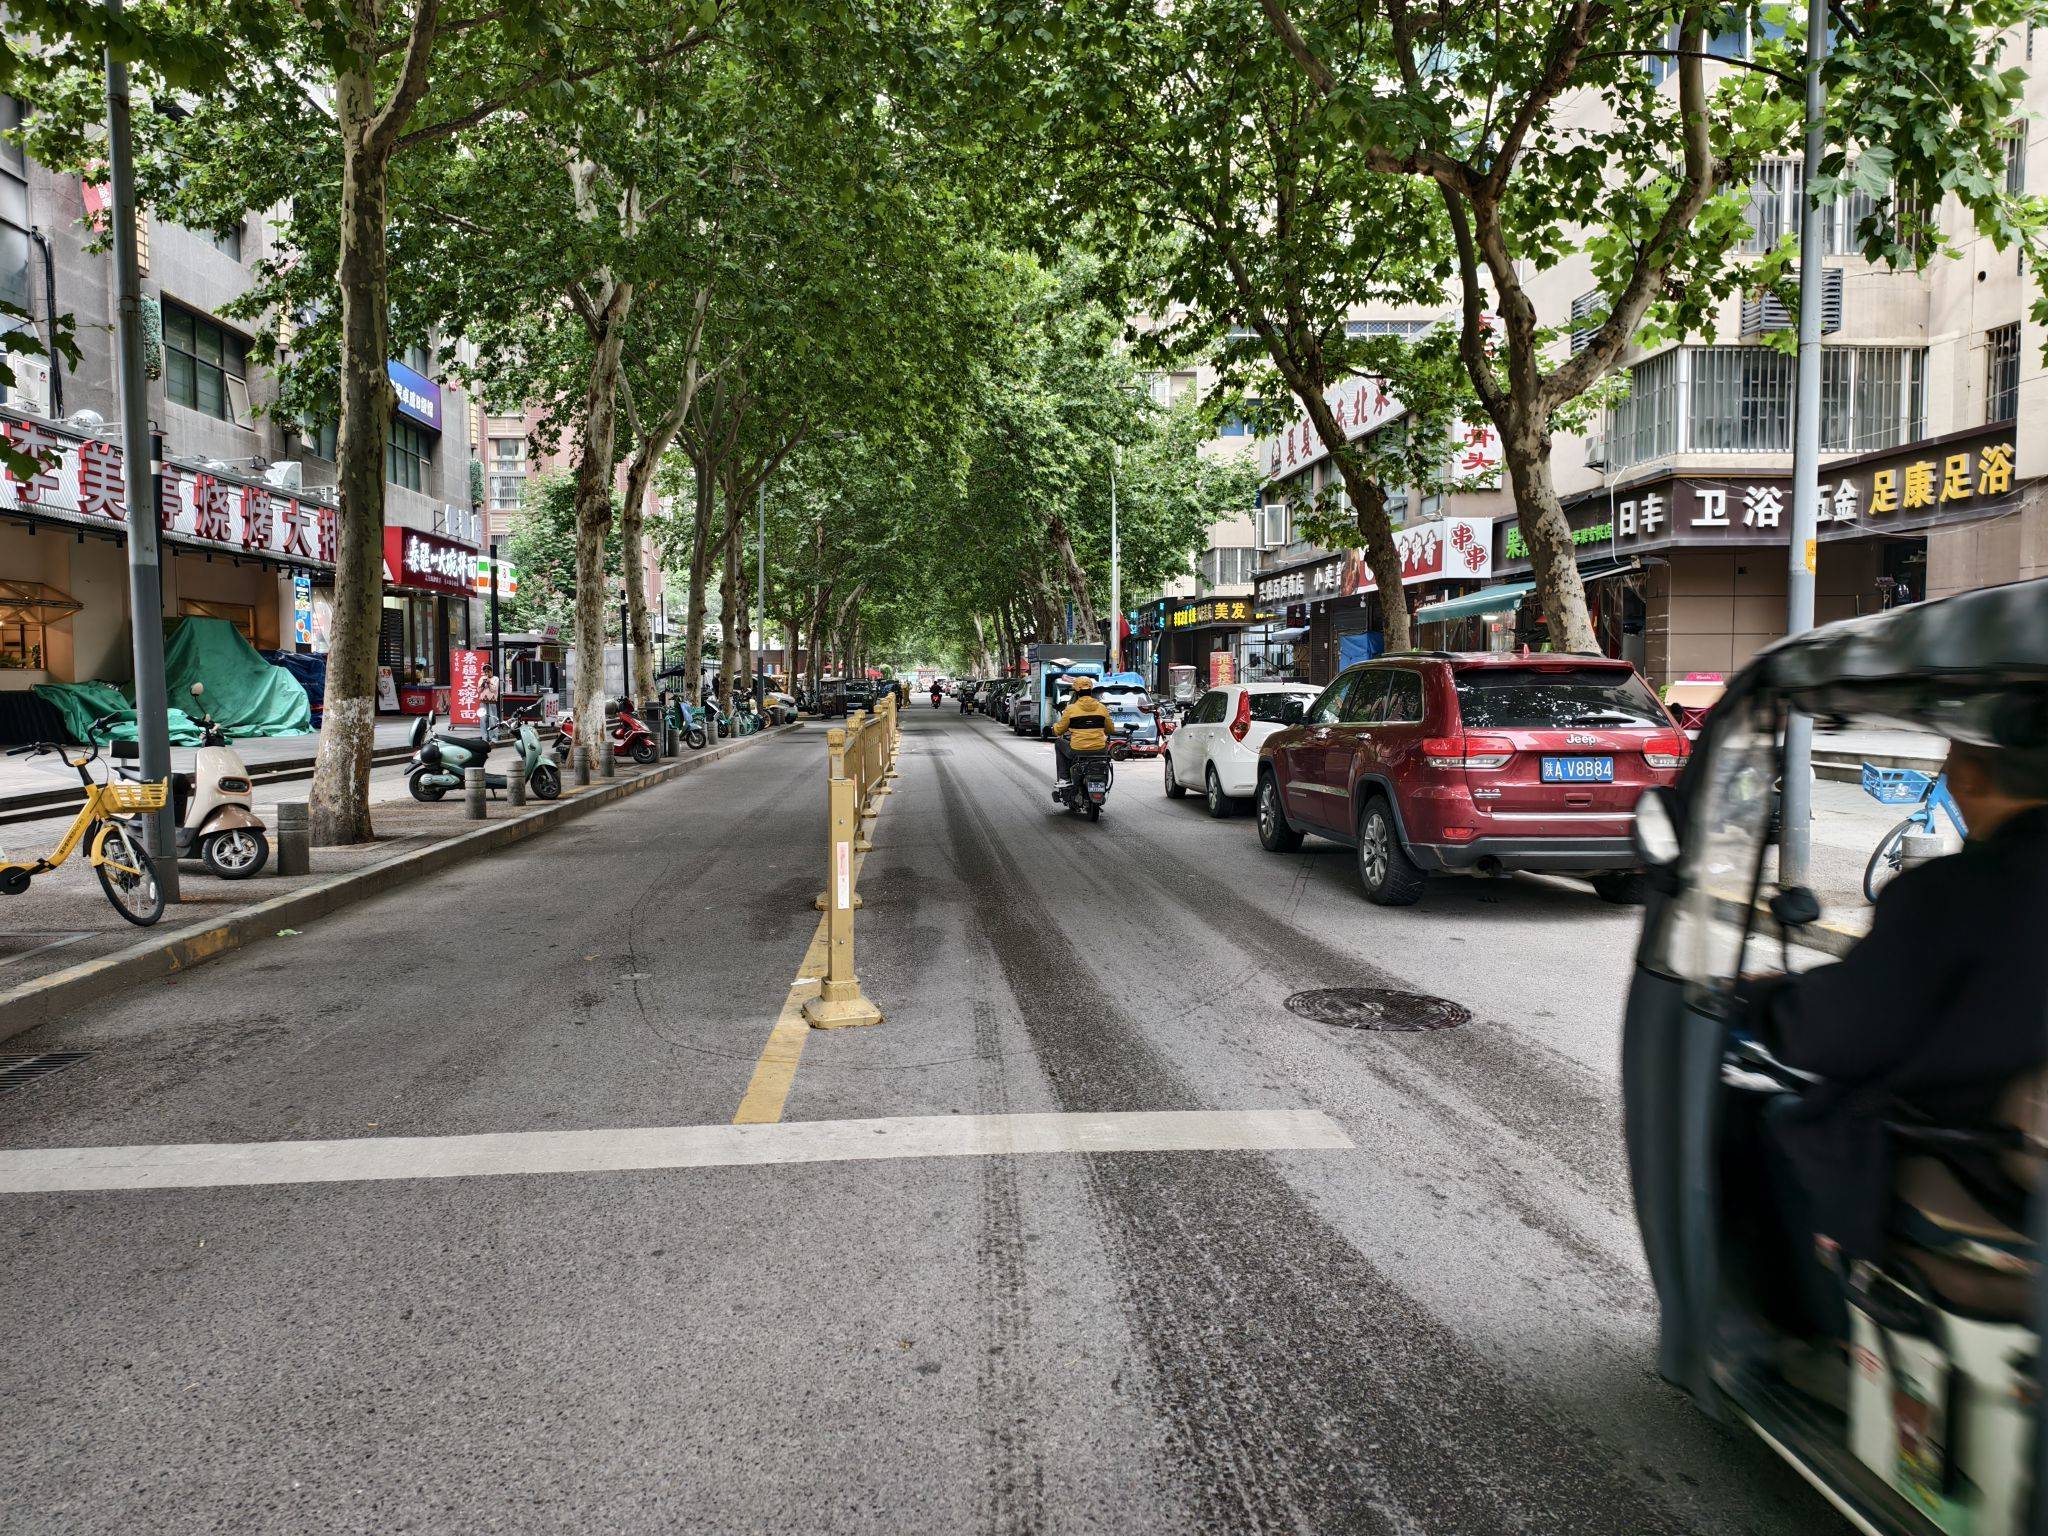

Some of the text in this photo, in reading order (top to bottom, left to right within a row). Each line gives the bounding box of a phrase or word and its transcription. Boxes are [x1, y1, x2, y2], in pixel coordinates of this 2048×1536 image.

[1869, 443, 2015, 515] 足康足浴
[1214, 602, 1246, 620] 美发
[1566, 734, 1596, 747] Jeep
